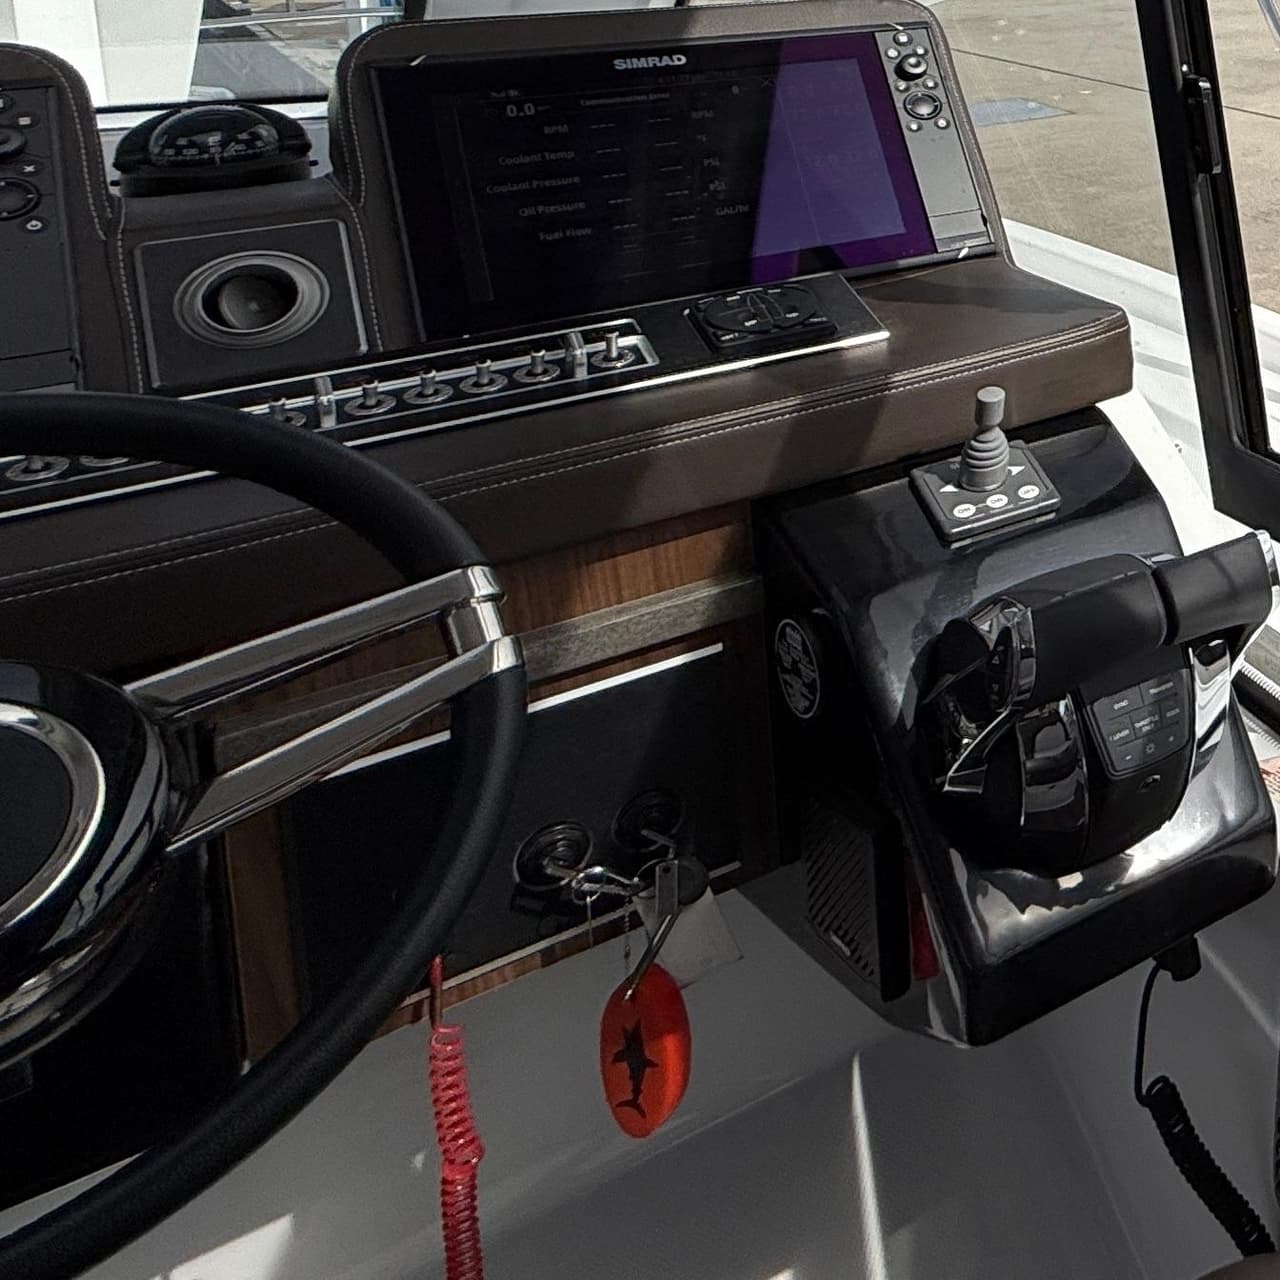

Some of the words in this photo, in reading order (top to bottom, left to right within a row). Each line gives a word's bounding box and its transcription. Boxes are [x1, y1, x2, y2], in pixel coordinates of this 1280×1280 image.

[613, 54, 687, 70] SIMRAD
[506, 103, 535, 117] 0.0
[497, 151, 542, 167] Coolant
[544, 149, 576, 163] Temp
[486, 180, 530, 194] Coolant
[532, 175, 582, 190] Pressure
[537, 200, 586, 216] Pressure
